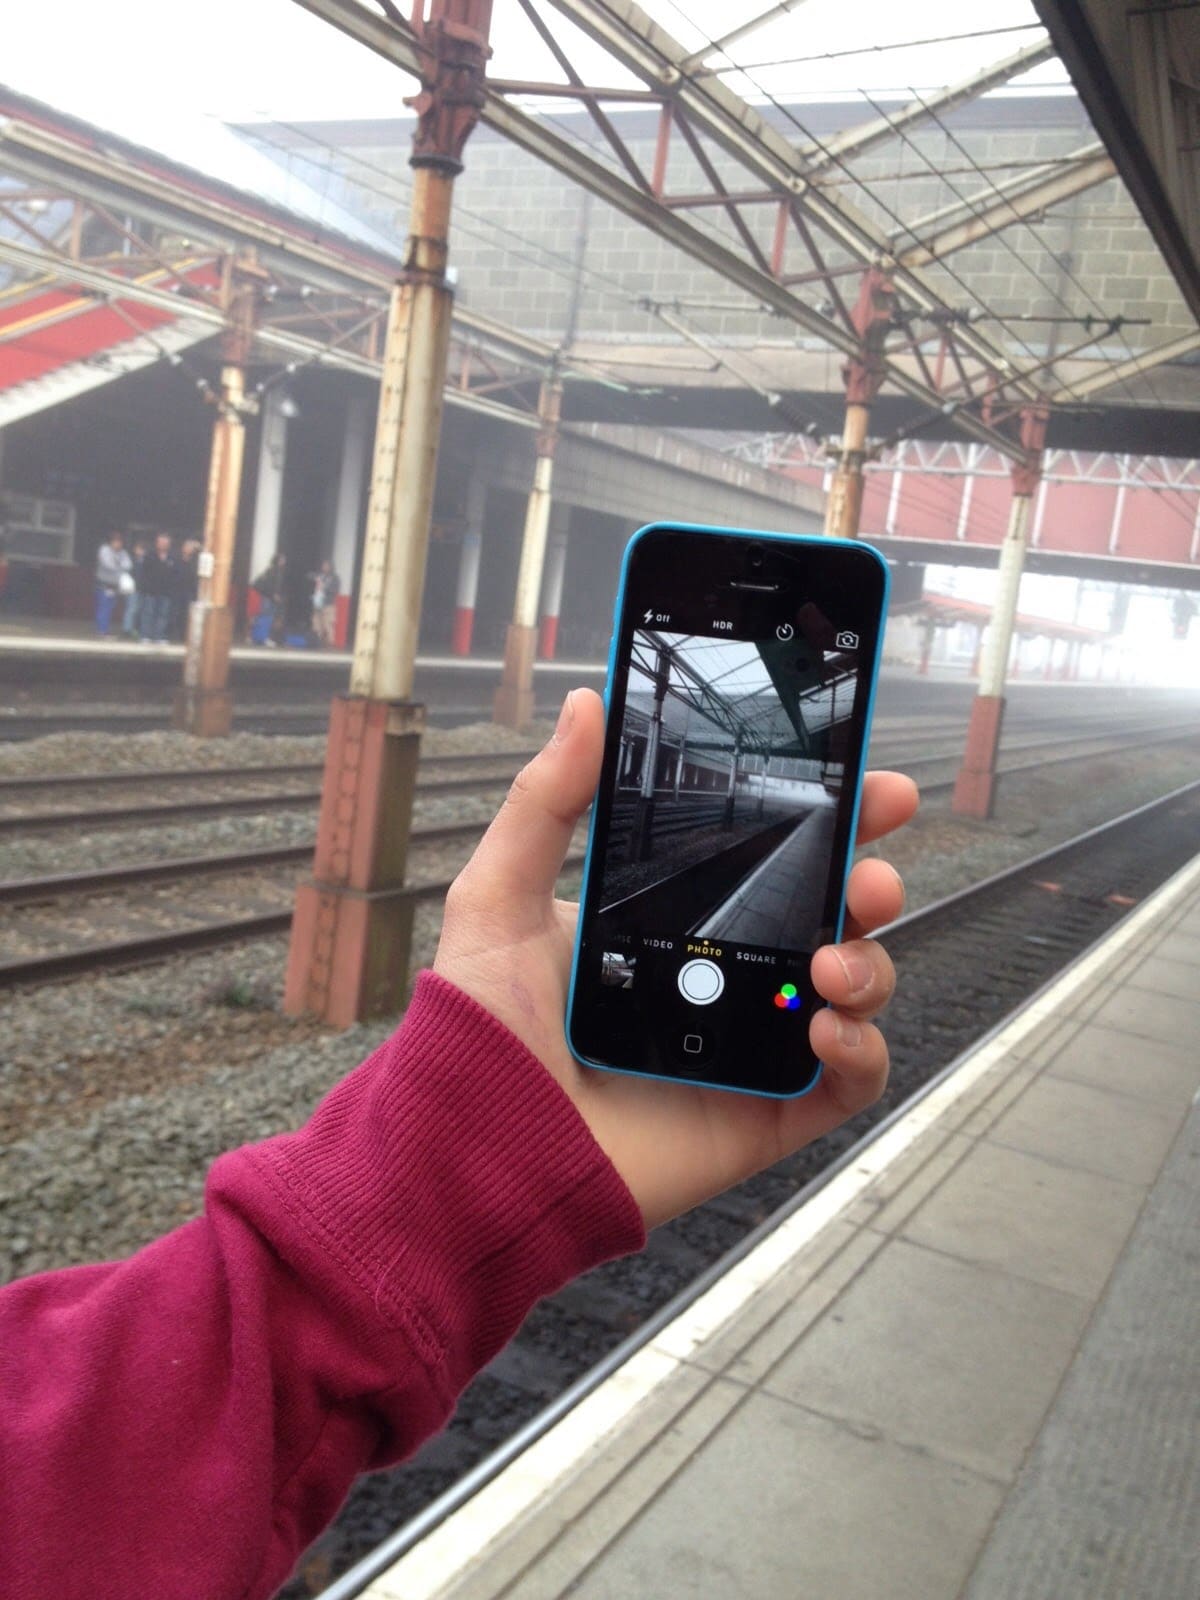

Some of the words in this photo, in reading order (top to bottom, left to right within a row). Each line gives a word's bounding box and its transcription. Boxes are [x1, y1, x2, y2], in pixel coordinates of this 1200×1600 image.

[656, 613, 670, 623] Off
[712, 620, 733, 631] HDR
[643, 937, 674, 950] VIDEO
[687, 944, 723, 957] PHOTO
[736, 951, 776, 965] SQUARE
